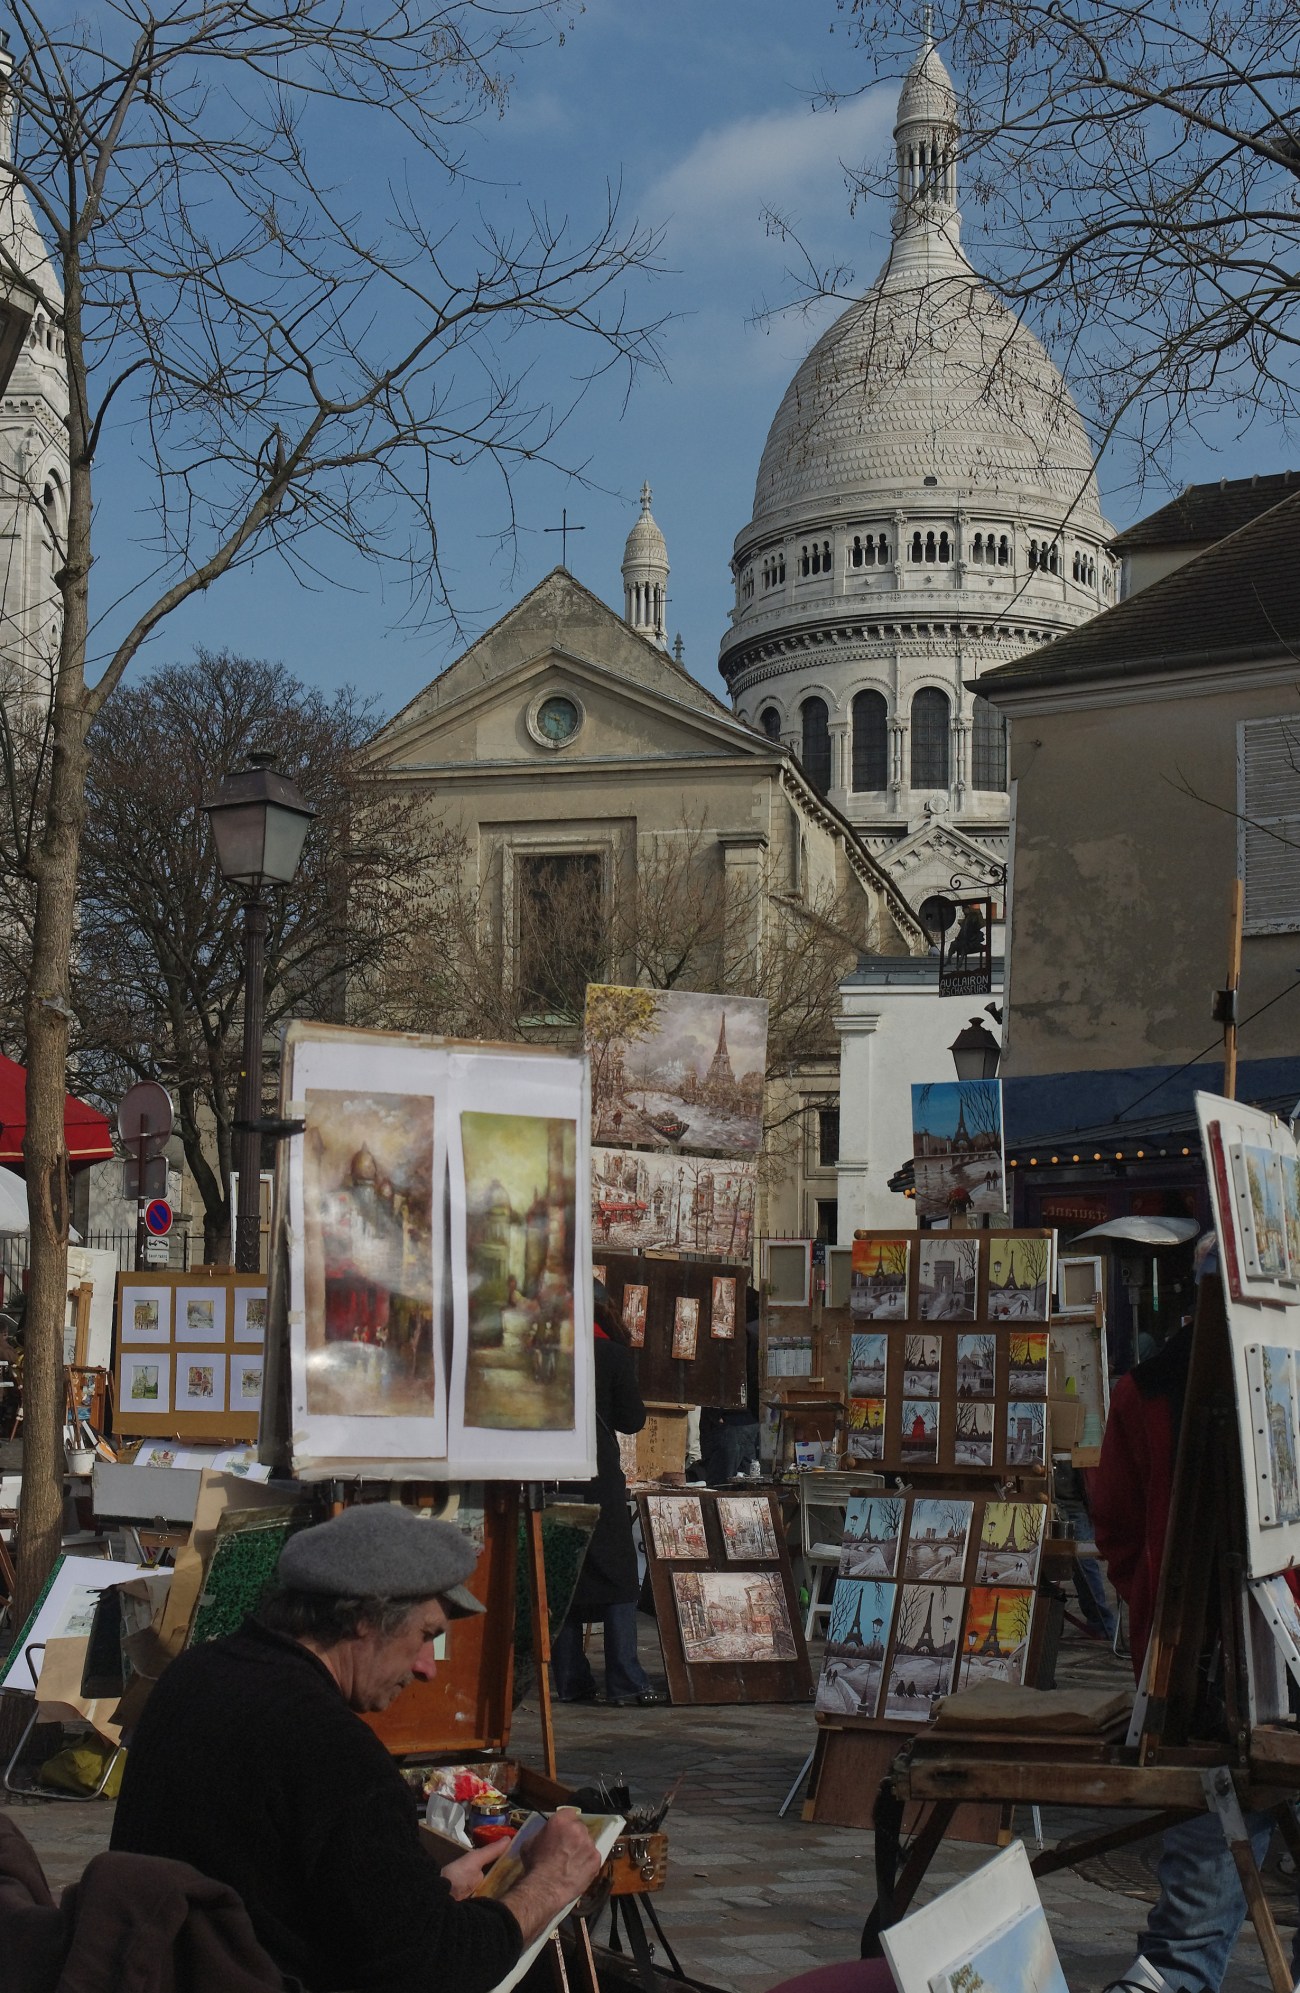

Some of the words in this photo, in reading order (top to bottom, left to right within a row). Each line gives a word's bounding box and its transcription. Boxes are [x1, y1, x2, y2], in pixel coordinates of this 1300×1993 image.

[940, 979, 951, 988] AU
[953, 974, 989, 987] CLAIRON
[951, 985, 988, 996] CHASSEURS
